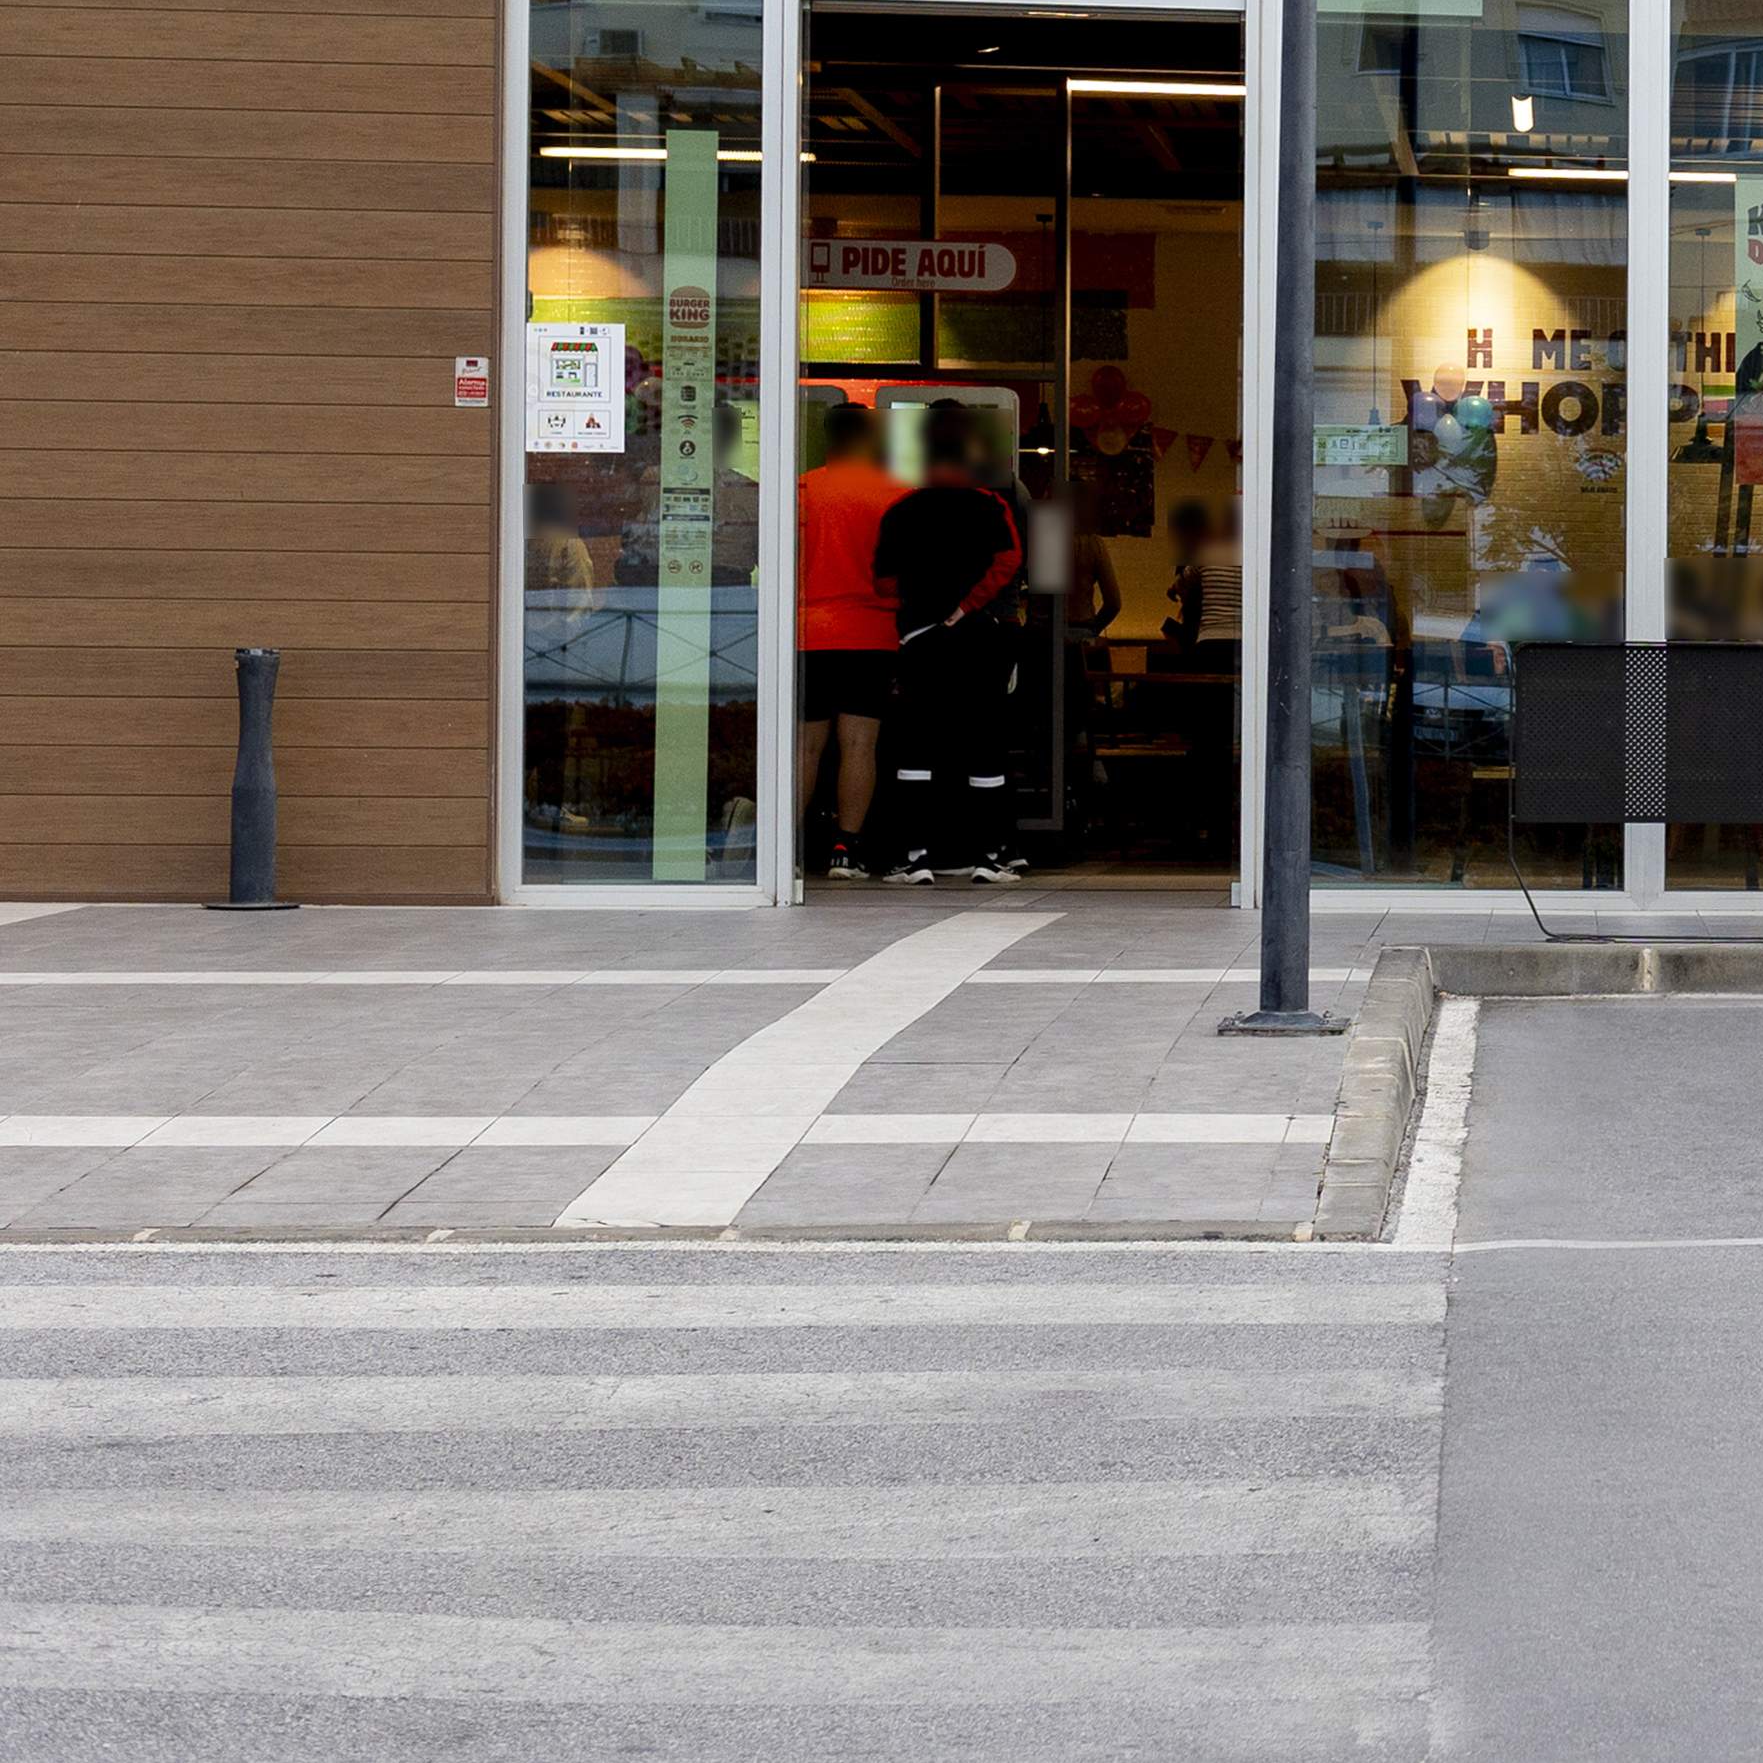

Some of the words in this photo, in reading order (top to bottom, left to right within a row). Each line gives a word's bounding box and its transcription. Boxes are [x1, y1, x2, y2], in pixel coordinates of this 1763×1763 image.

[842, 246, 907, 276] PIDE
[917, 243, 986, 278] AQUÍ
[892, 276, 915, 288] Order
[669, 299, 710, 308] BURGER
[670, 308, 710, 321] KING
